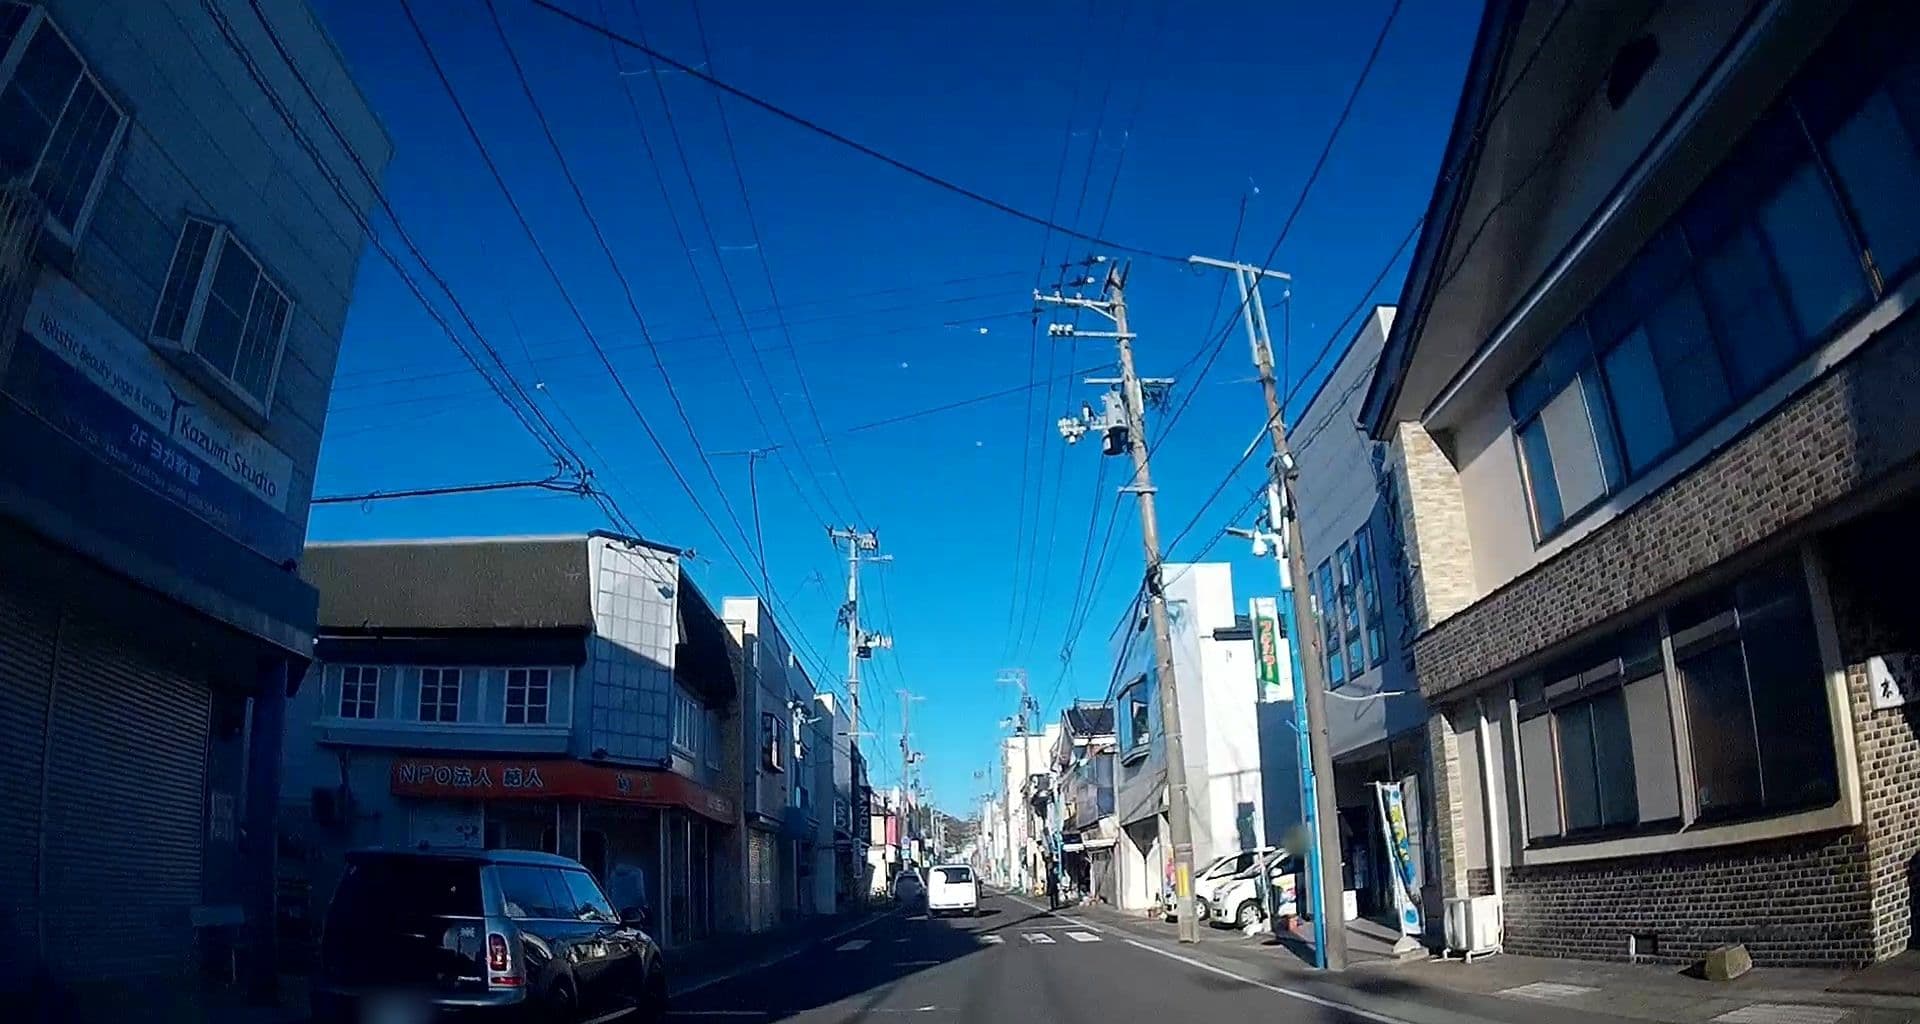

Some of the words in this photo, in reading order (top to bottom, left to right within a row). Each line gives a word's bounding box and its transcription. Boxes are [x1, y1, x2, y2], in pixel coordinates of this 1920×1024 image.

[130, 424, 149, 448] 2F
[181, 414, 229, 466] Kazumi
[232, 452, 277, 497] Studio
[400, 764, 493, 788] NPO法人
